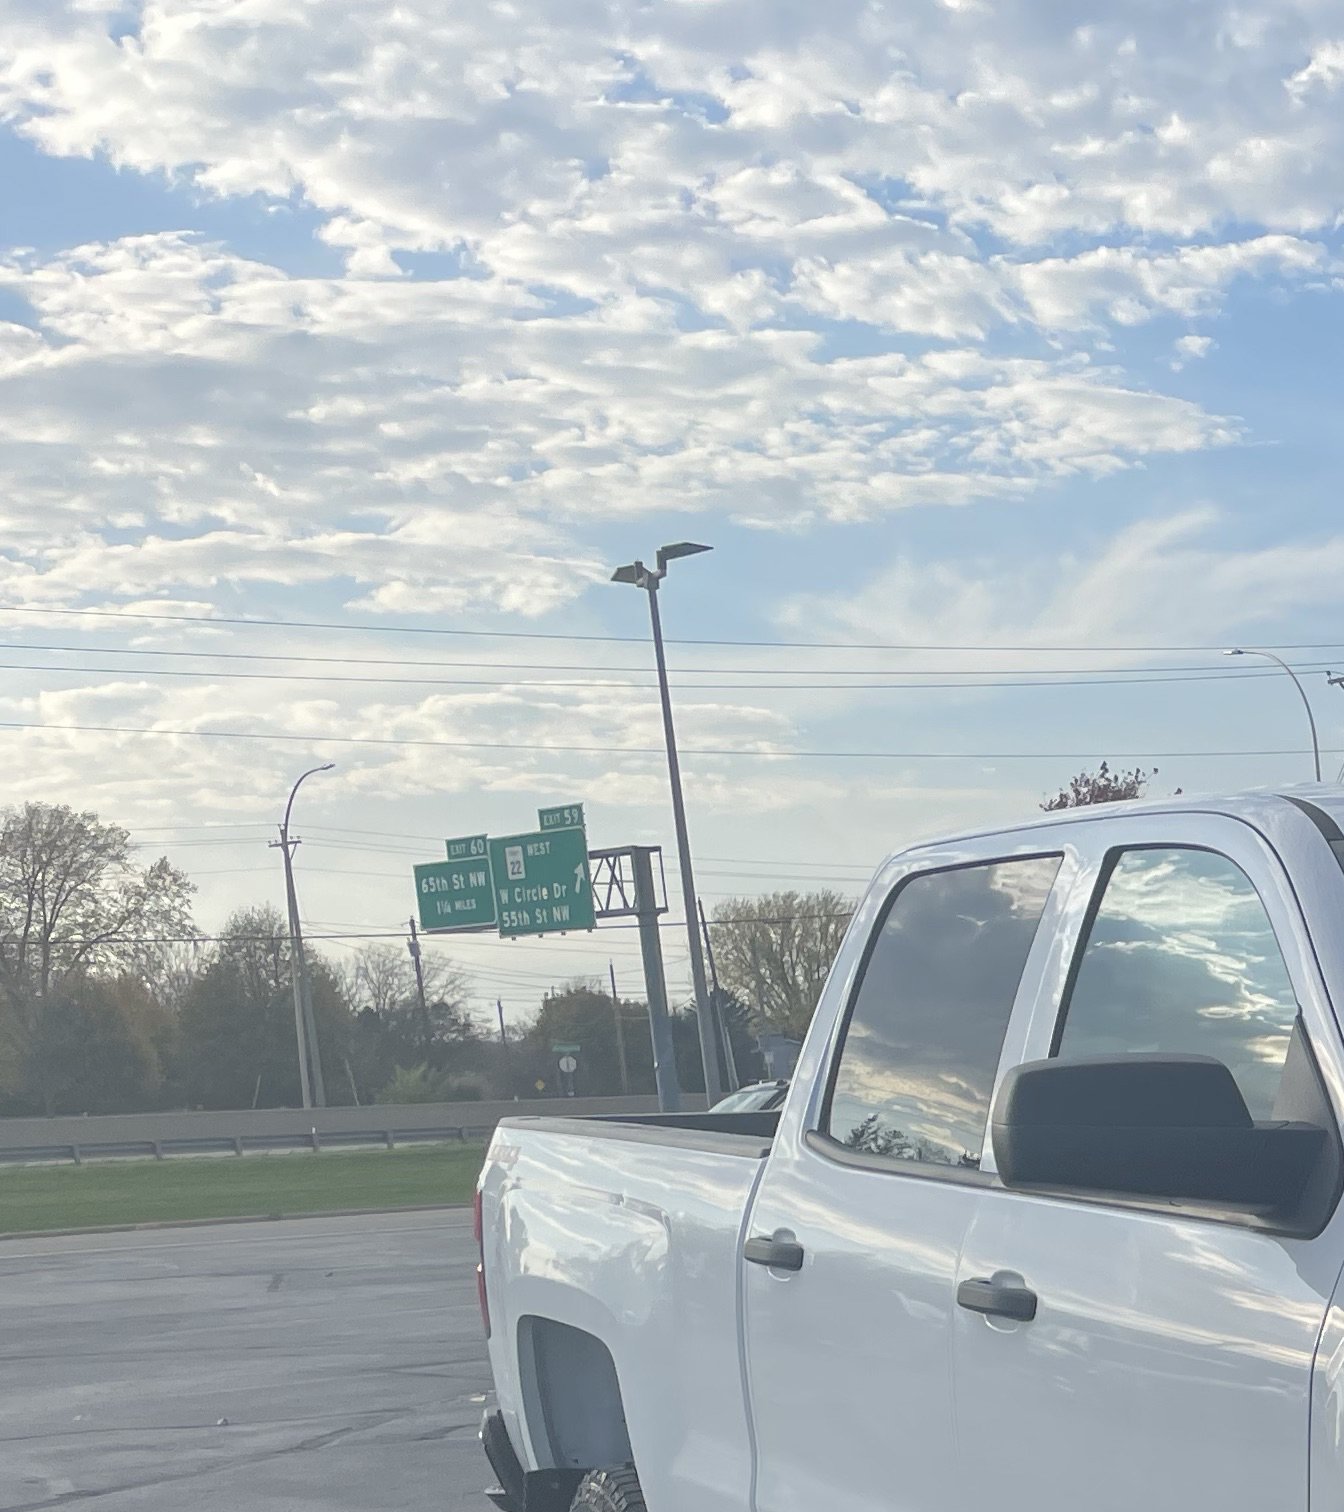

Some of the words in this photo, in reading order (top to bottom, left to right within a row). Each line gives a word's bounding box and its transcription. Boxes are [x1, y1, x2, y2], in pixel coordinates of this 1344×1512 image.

[543, 812, 561, 827] EXIT
[563, 808, 580, 825] 59
[450, 842, 466, 857] EXIT
[470, 838, 485, 855] 60
[527, 842, 551, 857] WEST
[509, 861, 523, 876] 22
[421, 876, 449, 894] 65th
[452, 873, 466, 889] St
[469, 871, 486, 887] NW
[499, 888, 509, 905] W
[514, 884, 548, 902] Circle
[553, 882, 567, 898] Dr
[502, 909, 530, 928] 55th
[535, 907, 549, 925] St
[553, 905, 570, 922] NW
